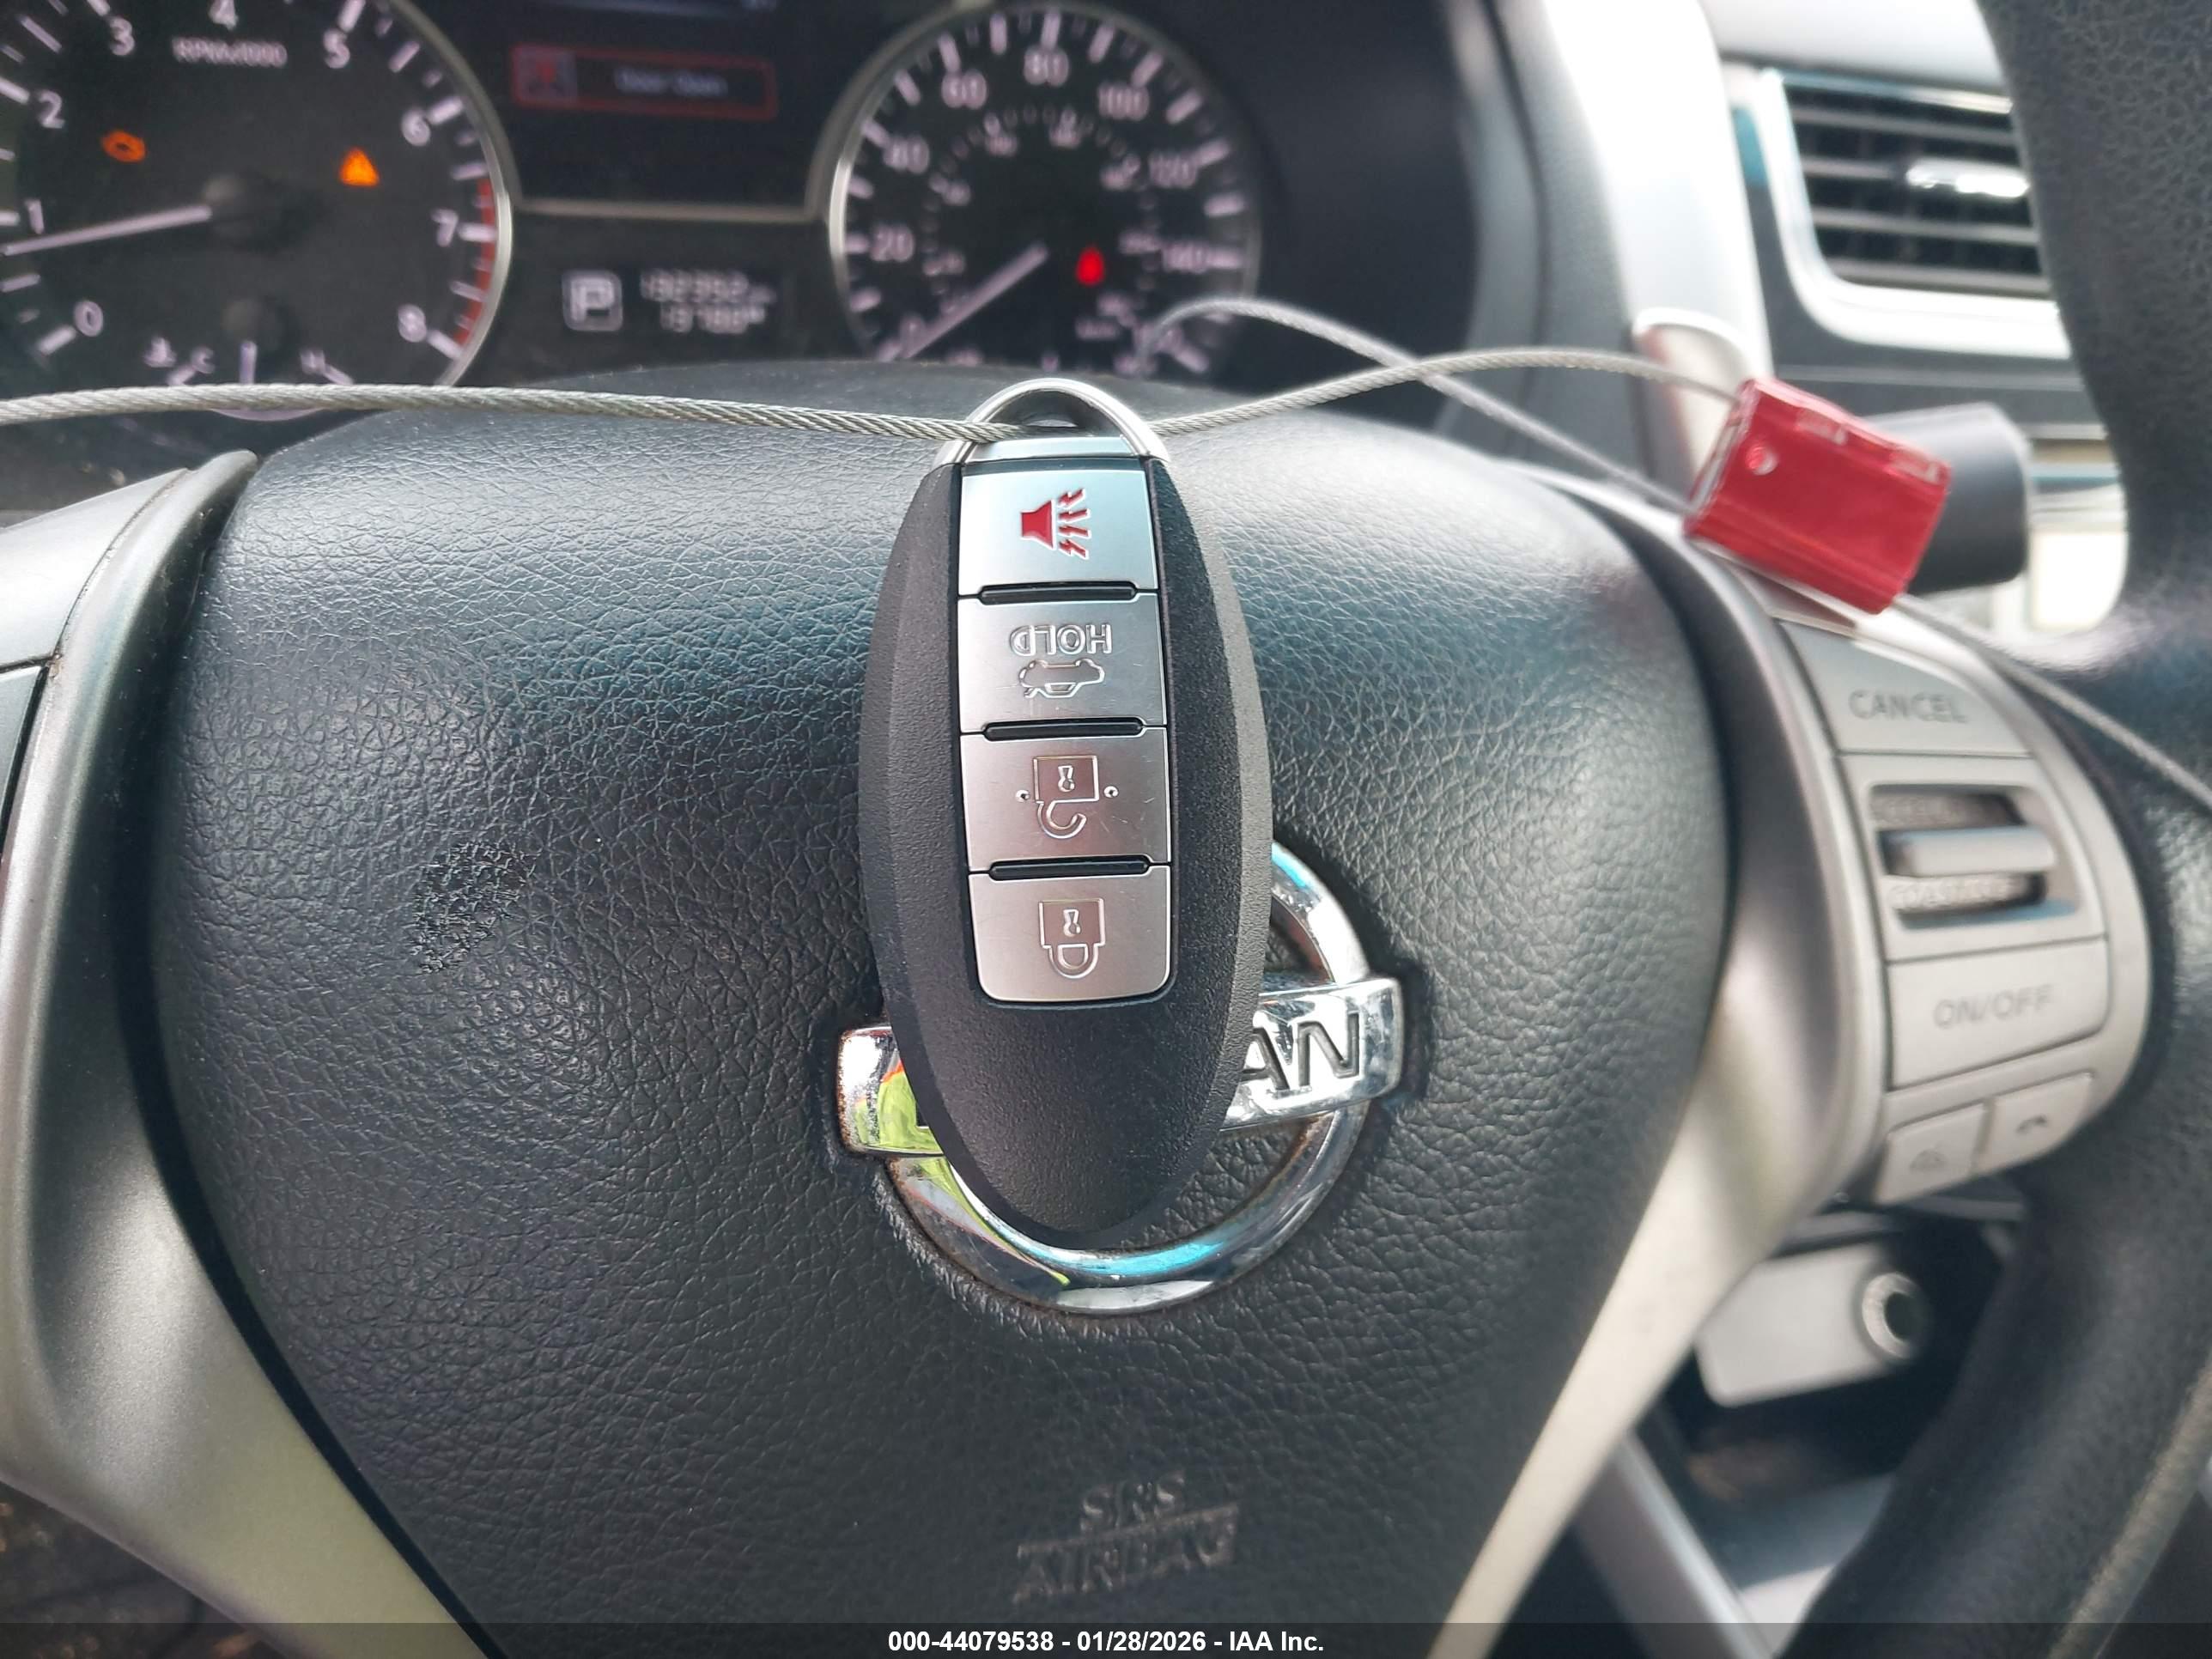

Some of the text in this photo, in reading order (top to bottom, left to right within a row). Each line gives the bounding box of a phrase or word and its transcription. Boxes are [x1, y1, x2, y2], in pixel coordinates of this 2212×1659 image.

[109, 16, 136, 56] 3
[323, 28, 353, 69] 5
[1024, 46, 1070, 86] 80
[37, 90, 64, 129] 2
[942, 70, 988, 110] 60
[1098, 82, 1151, 121] 100
[401, 109, 430, 146] 6
[26, 198, 45, 234] 1
[433, 209, 459, 247] 7
[870, 224, 915, 263] 20
[73, 300, 104, 337] 0
[569, 276, 617, 323] P
[397, 304, 427, 343] 8
[1009, 623, 1113, 657] HOLD
[1848, 688, 1969, 724] CANCEL
[1933, 983, 2052, 1030] ON/OFF
[1079, 1469, 1186, 1532] SRS
